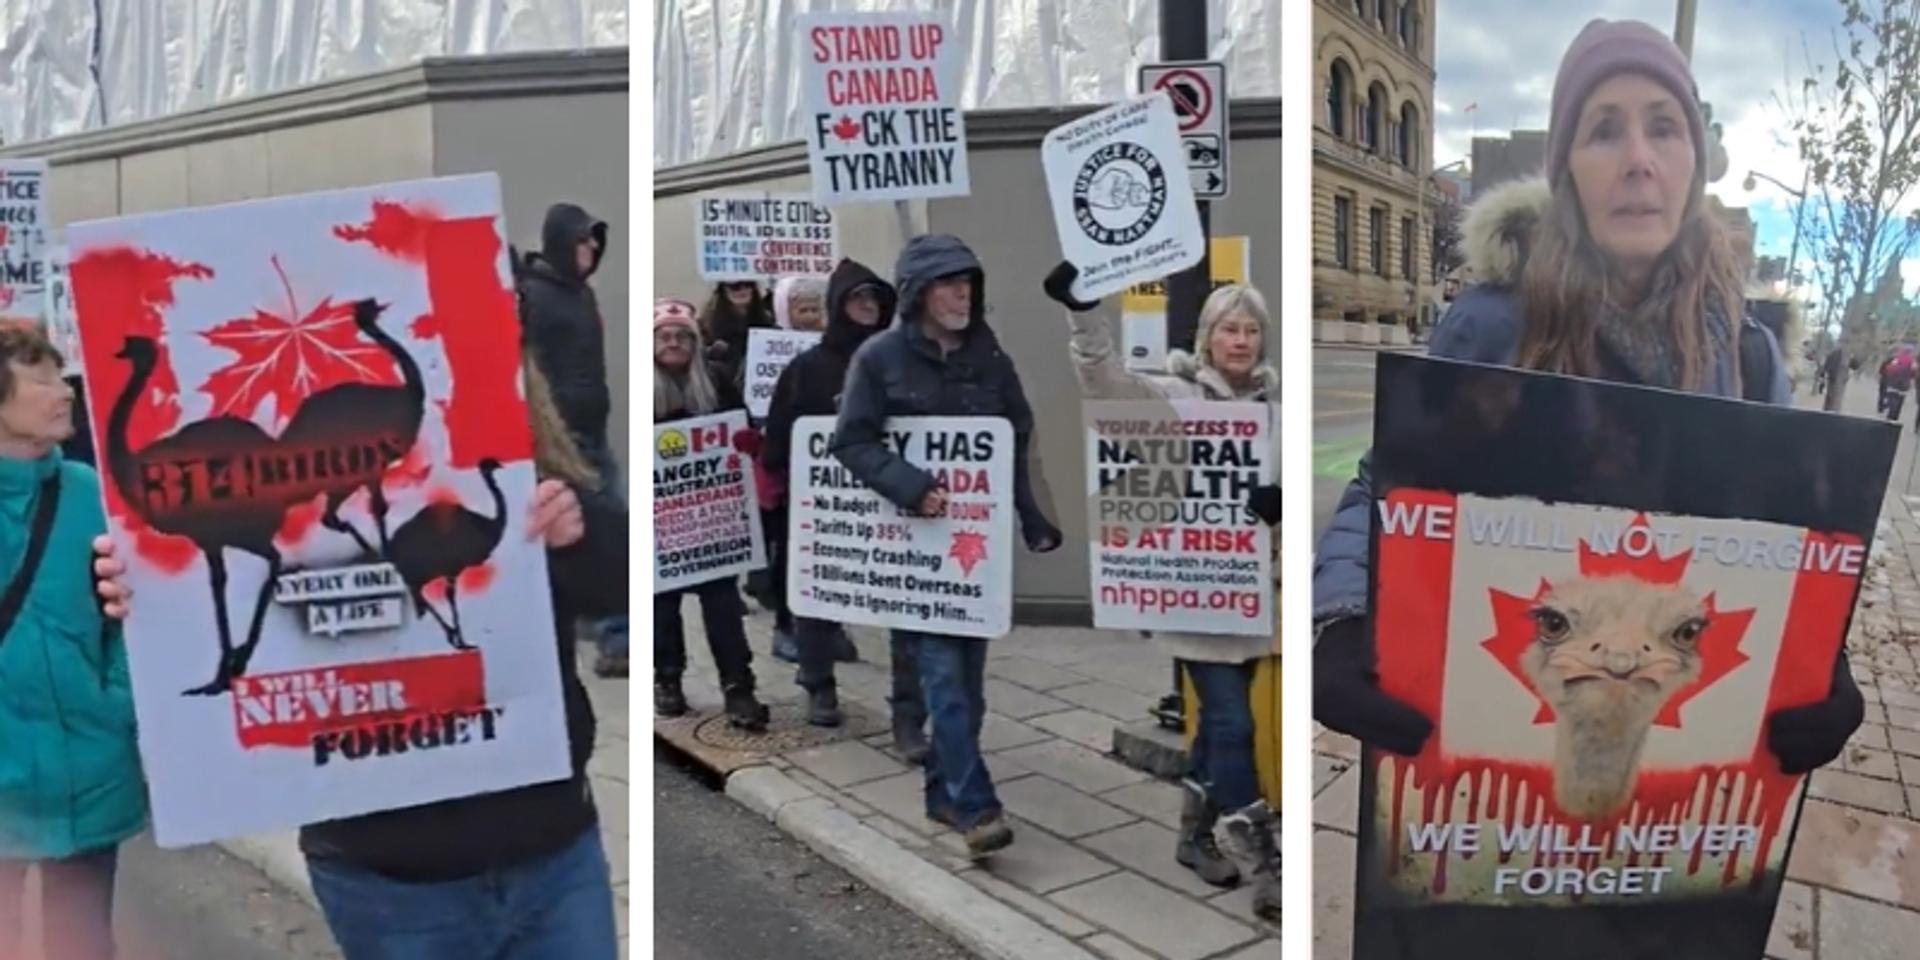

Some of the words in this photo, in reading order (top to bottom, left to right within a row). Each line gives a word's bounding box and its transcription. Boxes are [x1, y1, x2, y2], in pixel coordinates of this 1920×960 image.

[811, 25, 901, 63] STAND
[908, 24, 943, 59] UP
[827, 67, 939, 105] CANADA
[905, 108, 957, 144] THE
[825, 148, 955, 192] TYRANNY
[1075, 143, 1122, 198] JUSTICE
[1126, 143, 1158, 172] FOR
[703, 199, 782, 222] 15-MINUTE
[787, 201, 832, 224] CITIES
[703, 224, 750, 237] DIGITAL
[754, 259, 810, 274] CONTROL
[1096, 419, 1154, 436] YOUR
[1155, 420, 1229, 437] ACCESS
[1232, 420, 1258, 437] TO
[925, 431, 994, 462] HAS
[1097, 438, 1261, 467] NATURAL
[654, 456, 722, 484] ANGRY
[726, 454, 741, 470] &
[654, 471, 743, 498] RUSTRATED
[1099, 468, 1259, 500] HEALTH
[654, 485, 745, 514] CANADIANS
[833, 495, 880, 516] Budget
[1101, 501, 1260, 526] PRODUCTS
[813, 519, 853, 537] Tariffs
[857, 522, 875, 542] Up
[876, 523, 913, 541] 35%
[1101, 526, 1130, 548] IS
[1136, 527, 1174, 550] AT
[1182, 528, 1257, 553] RISK
[1378, 501, 1454, 541] WE
[1465, 510, 1576, 553] WILL
[1589, 523, 1684, 559] NOT
[1691, 534, 1867, 576] FORGIVE
[659, 551, 753, 579] GOVERNMENT
[813, 541, 870, 562] Economy
[872, 548, 942, 572] Crashing
[1102, 553, 1151, 566] Natural
[1155, 555, 1200, 568] Health
[1203, 556, 1260, 573] Product
[868, 571, 902, 589] Sent
[905, 576, 983, 598] Overseas
[1101, 566, 1172, 581] Protection
[1175, 570, 1258, 586] Association
[812, 586, 850, 608] Trump
[1101, 582, 1260, 618] nhppa.org
[314, 609, 328, 625] A
[336, 603, 385, 621] LIFE
[259, 670, 346, 694] WILL
[240, 680, 406, 727] NEVER
[313, 704, 505, 767] FORGET
[1408, 823, 1483, 853] WE
[1496, 823, 1603, 853] WILL
[1615, 823, 1758, 854] NEVER
[1493, 866, 1674, 896] FORGET
